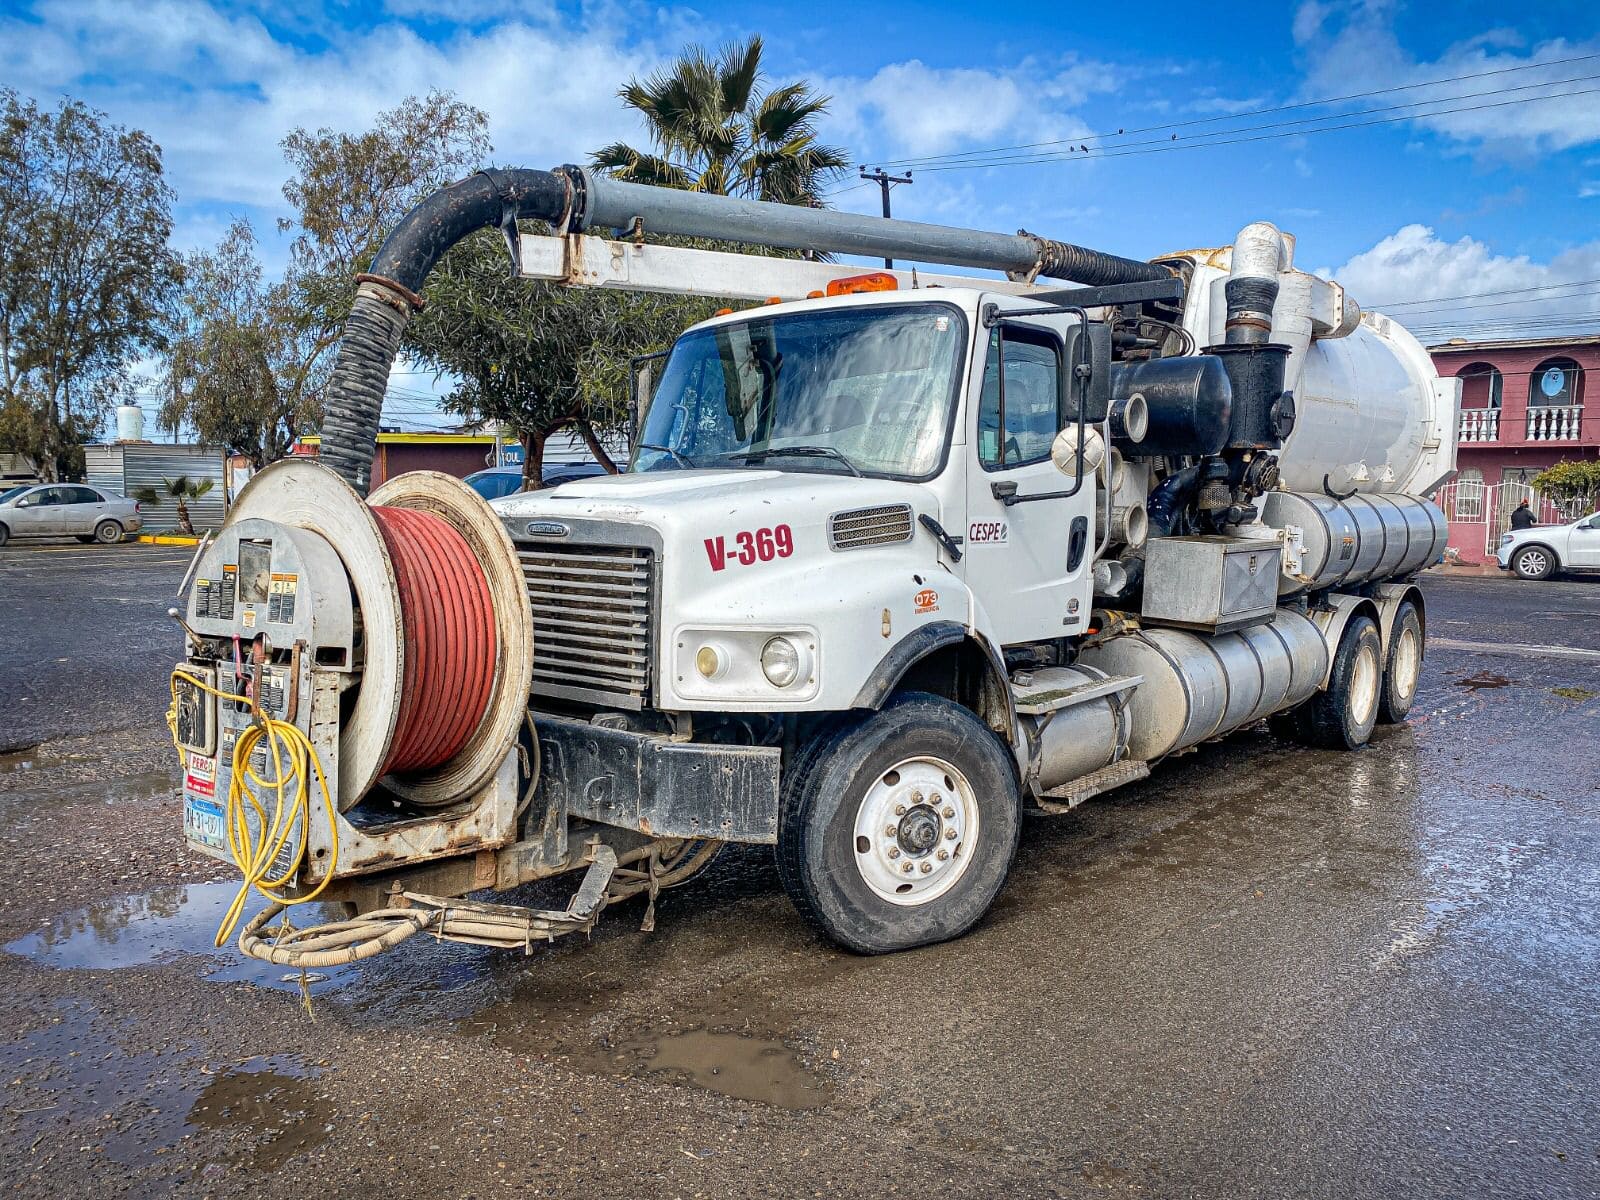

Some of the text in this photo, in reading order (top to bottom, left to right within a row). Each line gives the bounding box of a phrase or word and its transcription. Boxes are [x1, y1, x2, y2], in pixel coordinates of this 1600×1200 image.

[969, 522, 1001, 541] CESPE
[703, 524, 794, 572] V-369
[916, 592, 938, 605] 073
